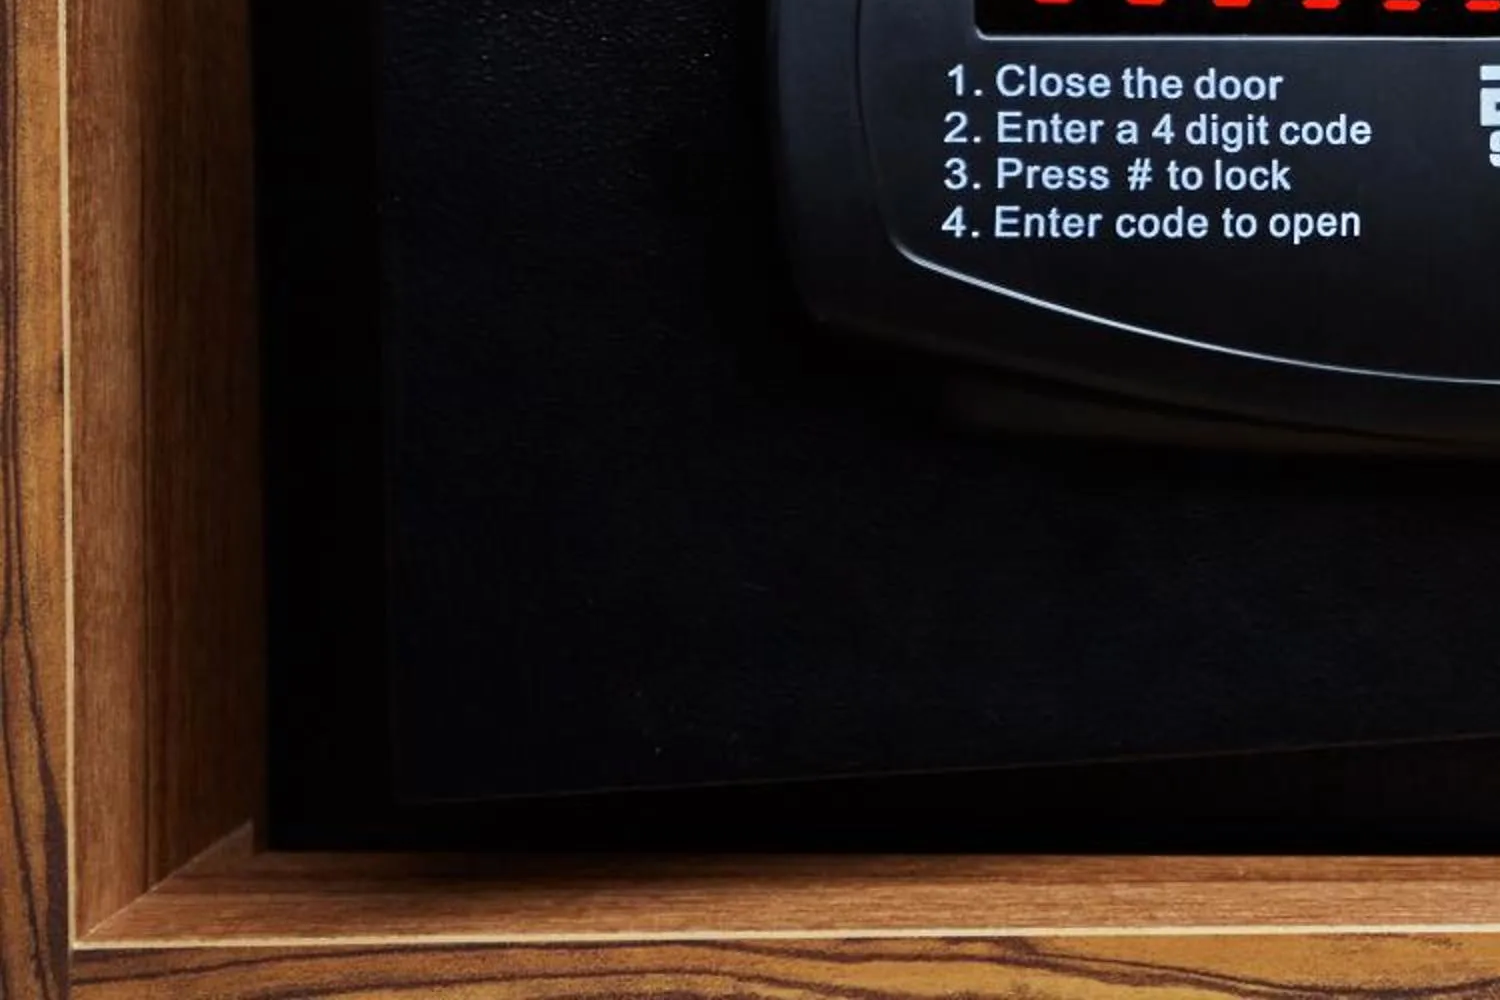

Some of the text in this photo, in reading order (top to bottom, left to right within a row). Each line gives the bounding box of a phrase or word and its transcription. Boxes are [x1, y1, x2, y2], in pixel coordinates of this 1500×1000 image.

[948, 64, 1284, 101] 1. Close the door
[943, 111, 1372, 153] 2. Enter a 4 digit code
[944, 157, 1291, 191] 3. Press # to lock
[941, 205, 1361, 245] 4. Enter code to open
